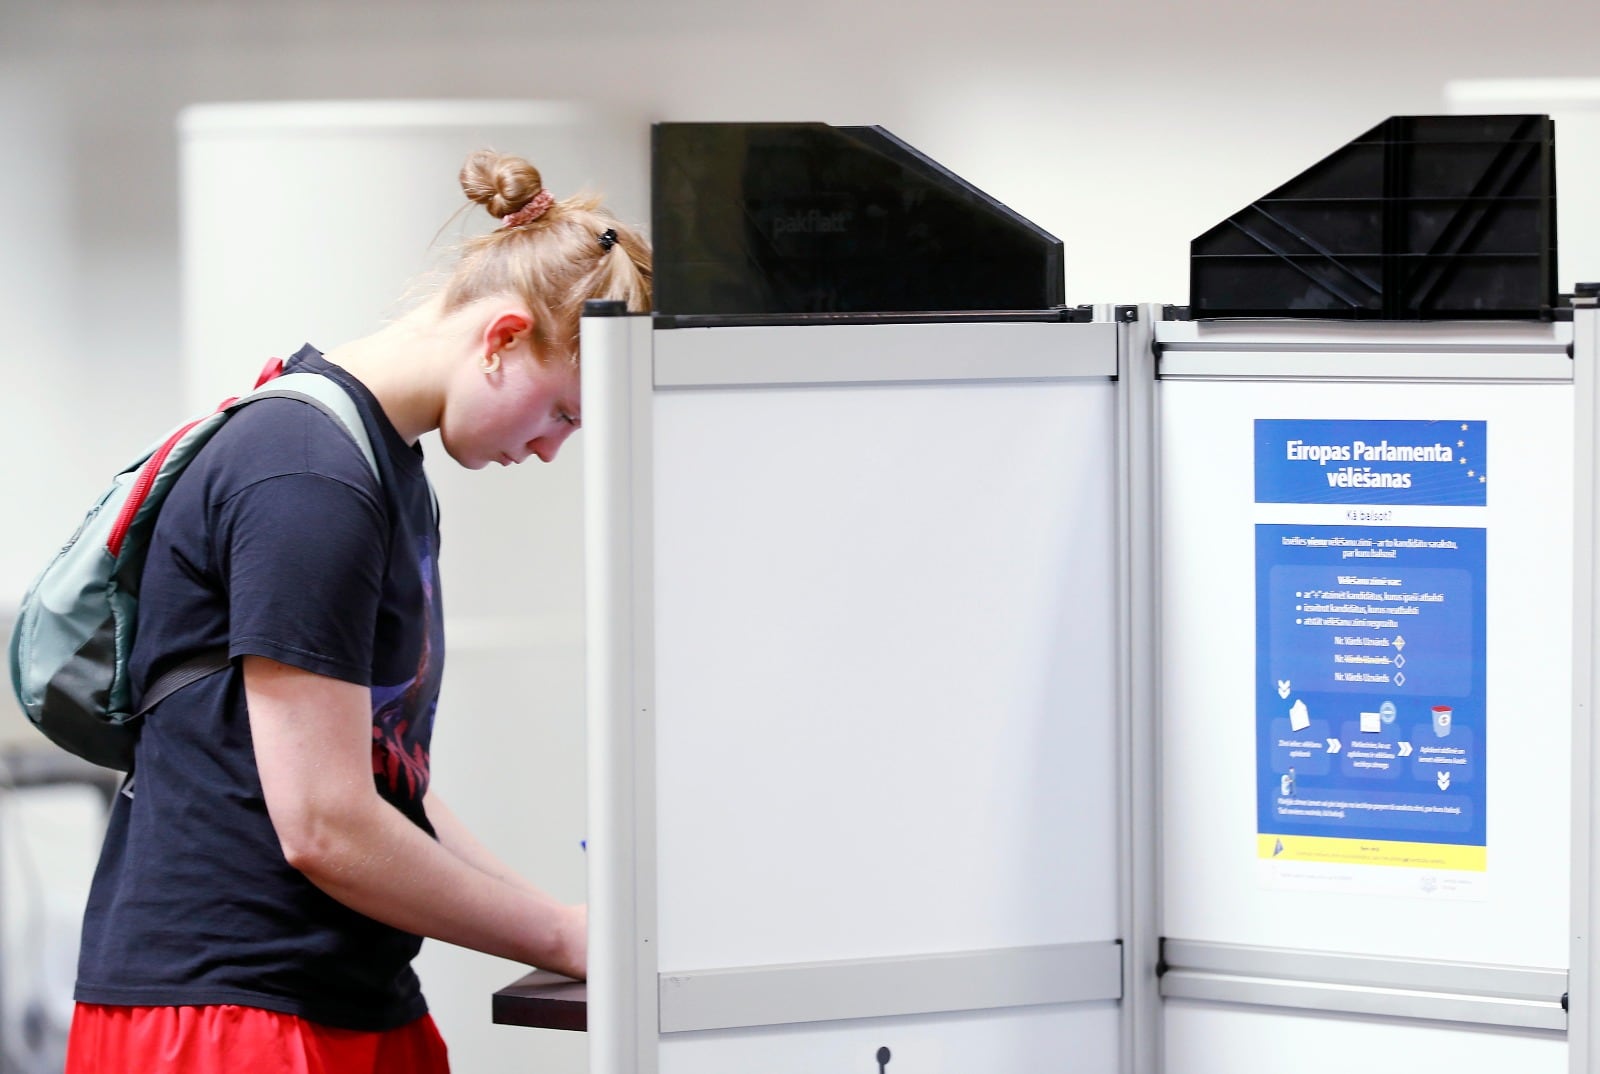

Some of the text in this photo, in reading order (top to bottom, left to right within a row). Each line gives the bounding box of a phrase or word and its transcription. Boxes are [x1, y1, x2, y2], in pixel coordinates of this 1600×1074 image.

[1287, 440, 1452, 465] Eiropas Parlamenta
[1326, 467, 1411, 488] vēlēšanas
